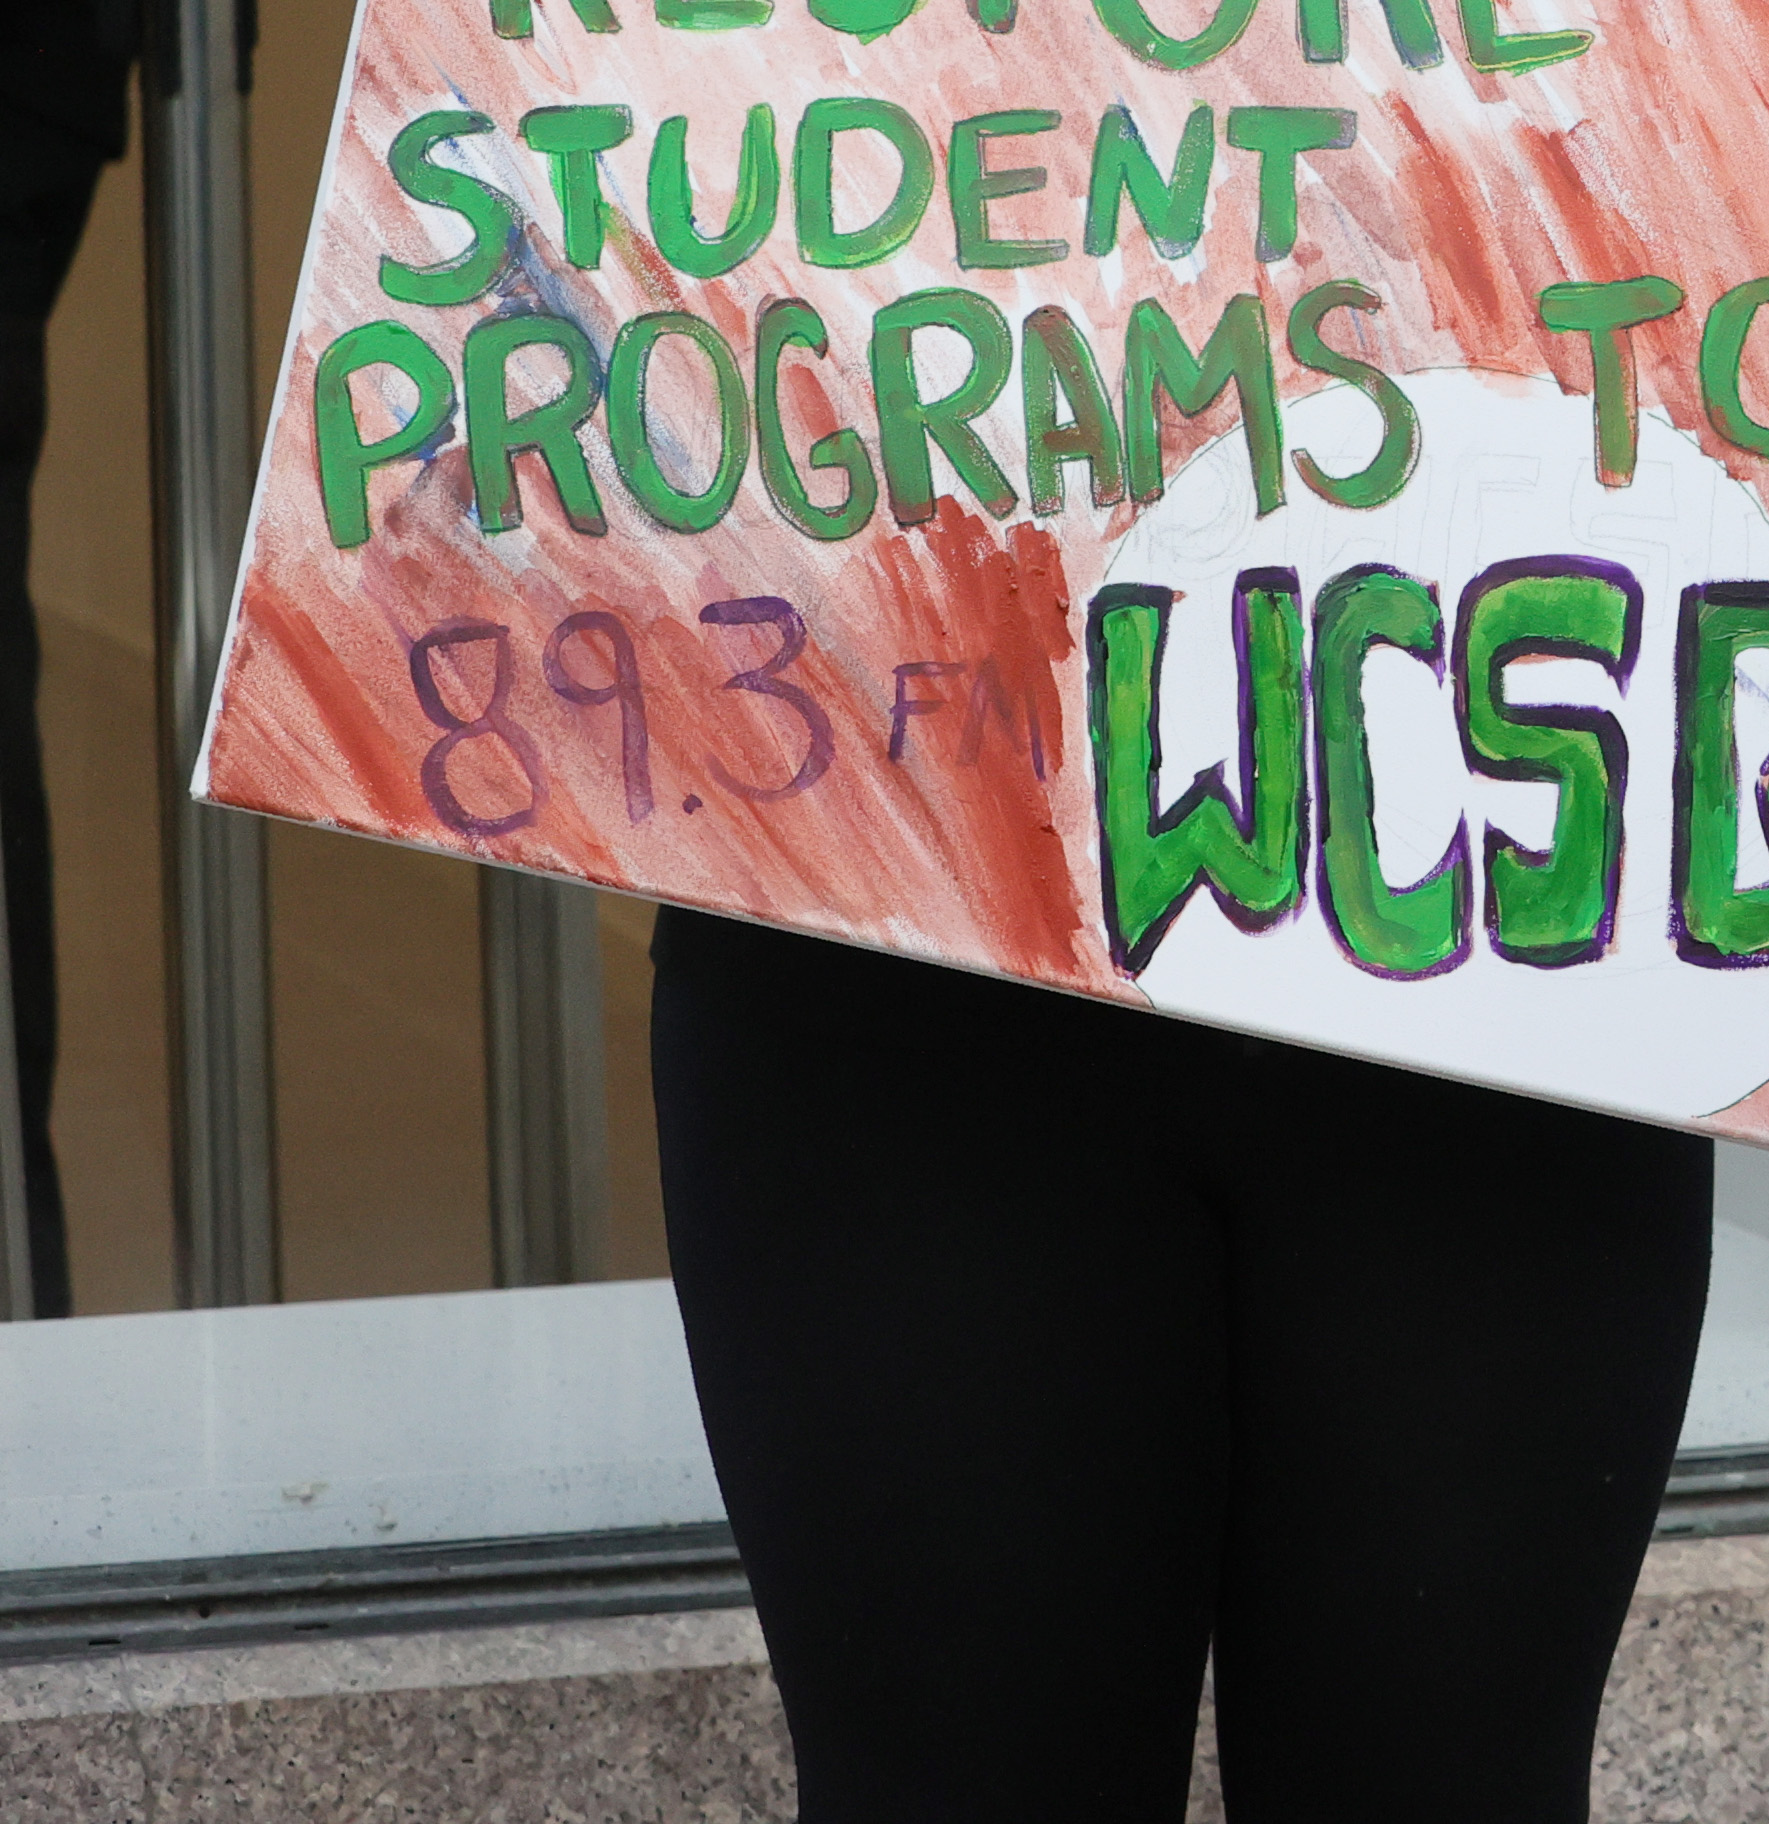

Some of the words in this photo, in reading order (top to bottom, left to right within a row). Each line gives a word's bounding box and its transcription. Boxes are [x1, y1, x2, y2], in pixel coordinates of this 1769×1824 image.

[380, 99, 1356, 304] STUDENT
[314, 281, 1419, 548] PROGRAMS
[409, 596, 834, 838] 89.3
[890, 658, 1048, 782] FM
